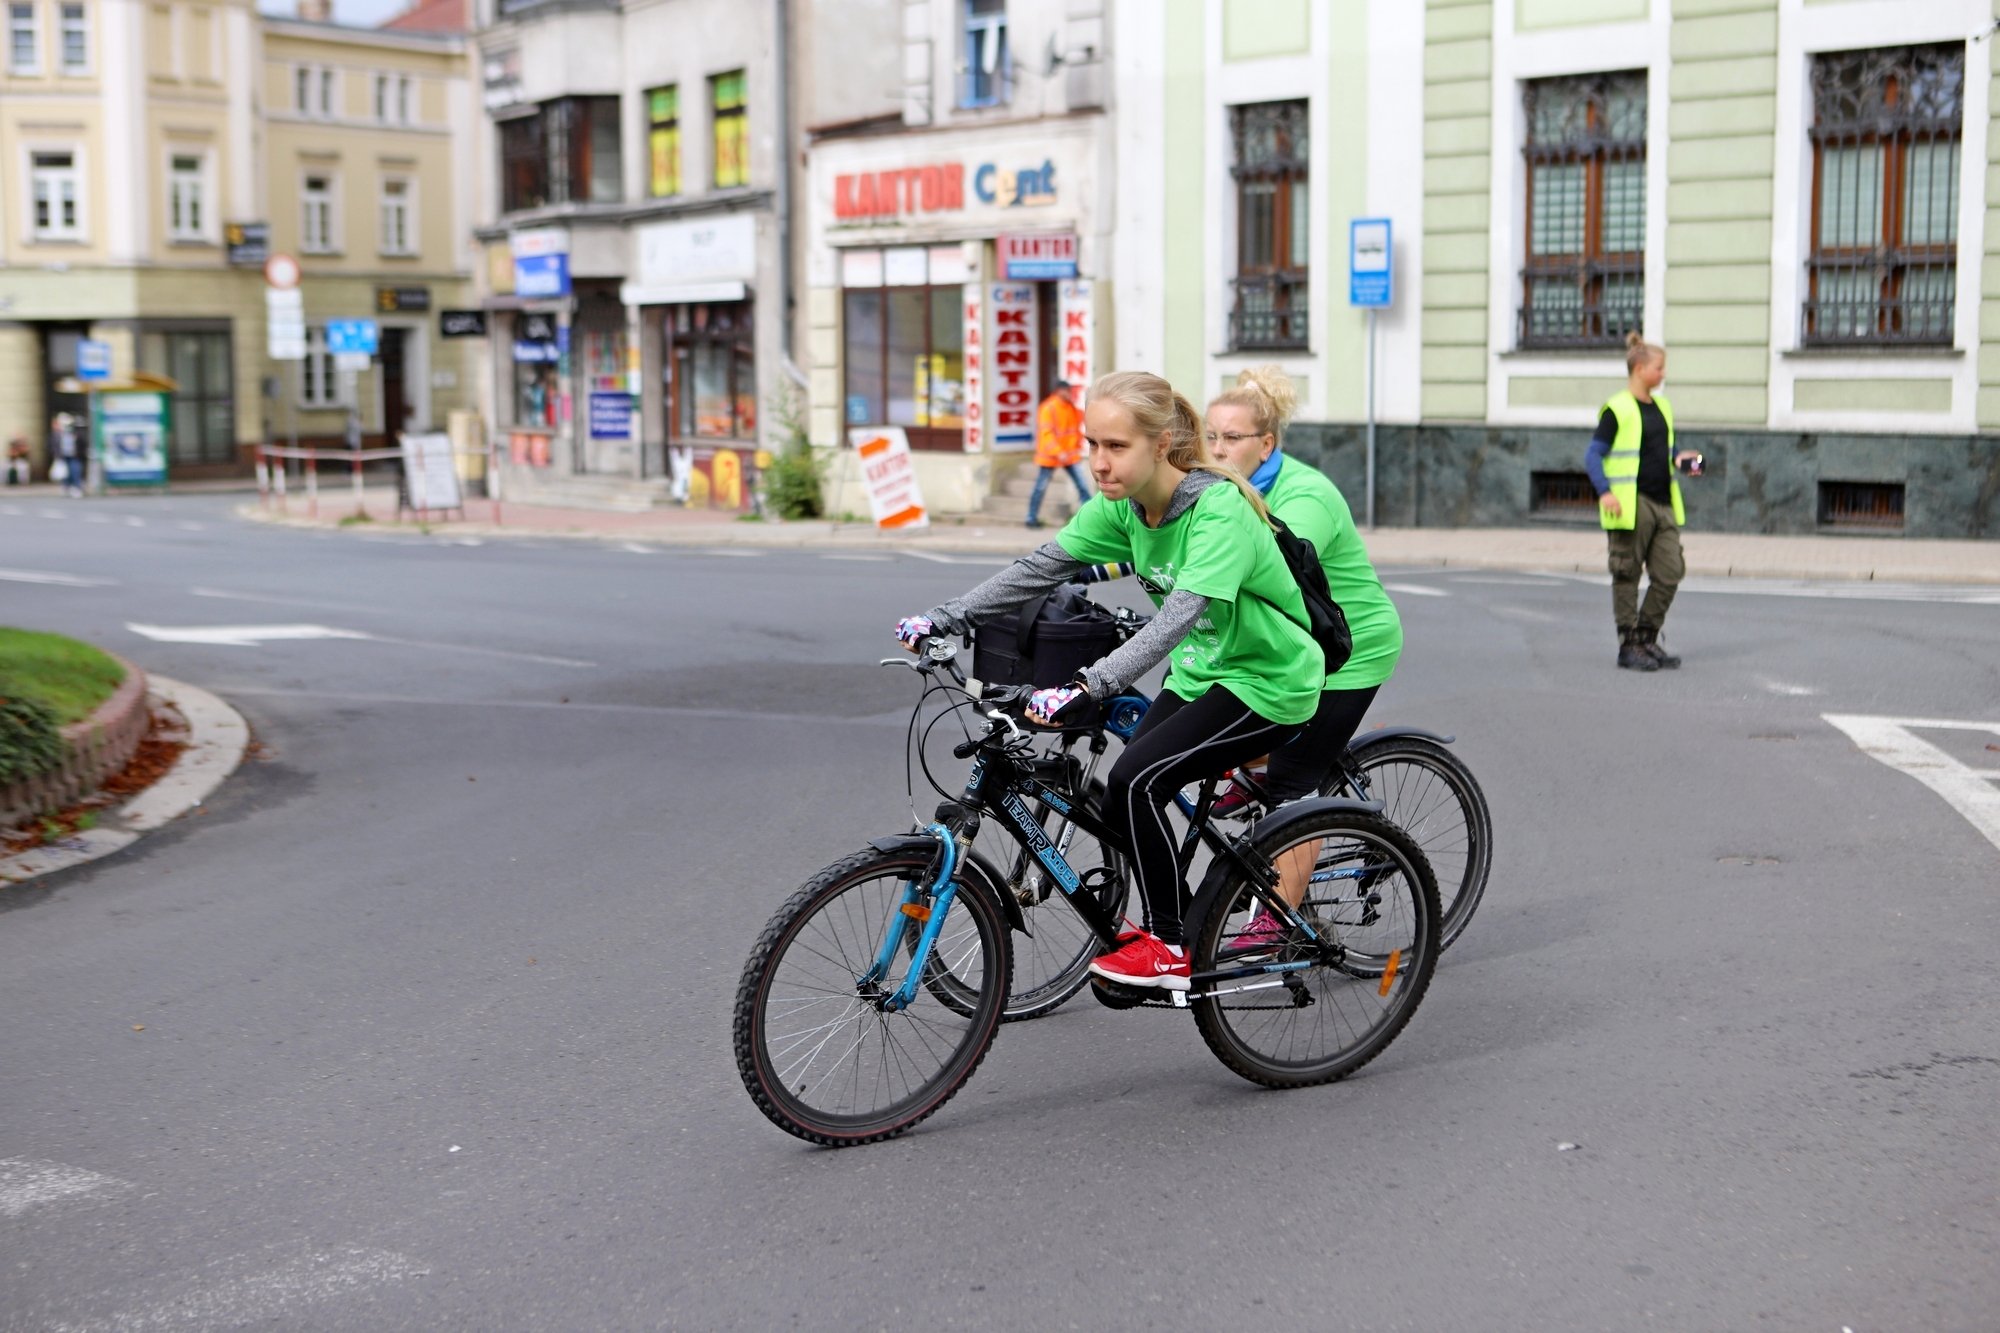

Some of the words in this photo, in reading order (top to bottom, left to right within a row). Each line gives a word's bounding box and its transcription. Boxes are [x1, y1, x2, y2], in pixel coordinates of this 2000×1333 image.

[833, 162, 965, 219] KANTOR
[974, 158, 1057, 208] Cent
[1009, 239, 1073, 257] KANTOR
[966, 304, 980, 446] KANTOR
[996, 310, 1031, 428] KANTOR
